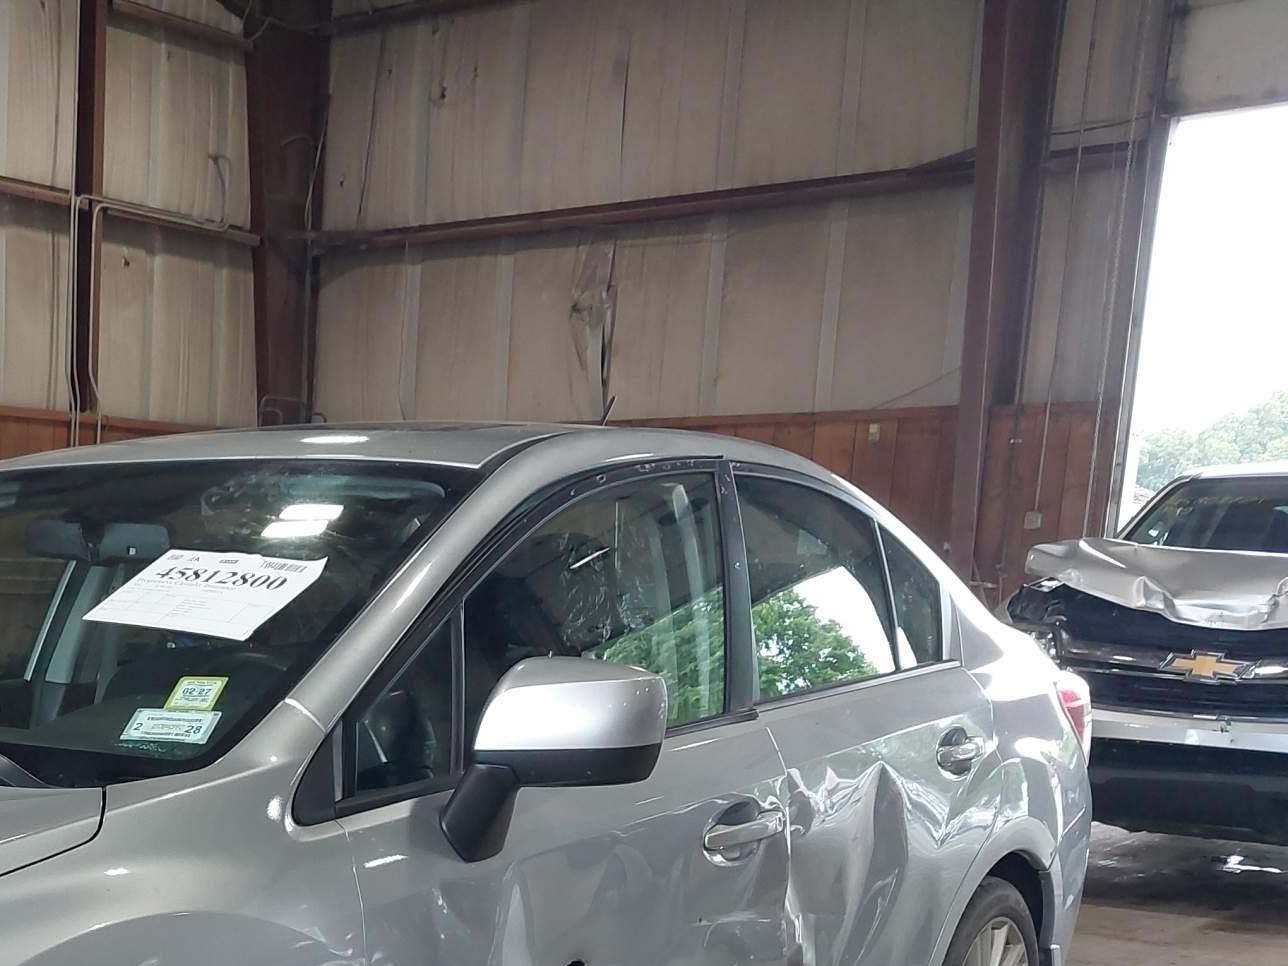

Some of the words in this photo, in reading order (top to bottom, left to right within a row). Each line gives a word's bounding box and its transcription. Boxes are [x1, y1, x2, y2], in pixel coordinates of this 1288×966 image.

[155, 565, 288, 591] 45812800
[133, 722, 144, 731] 2
[184, 725, 203, 734] 28
